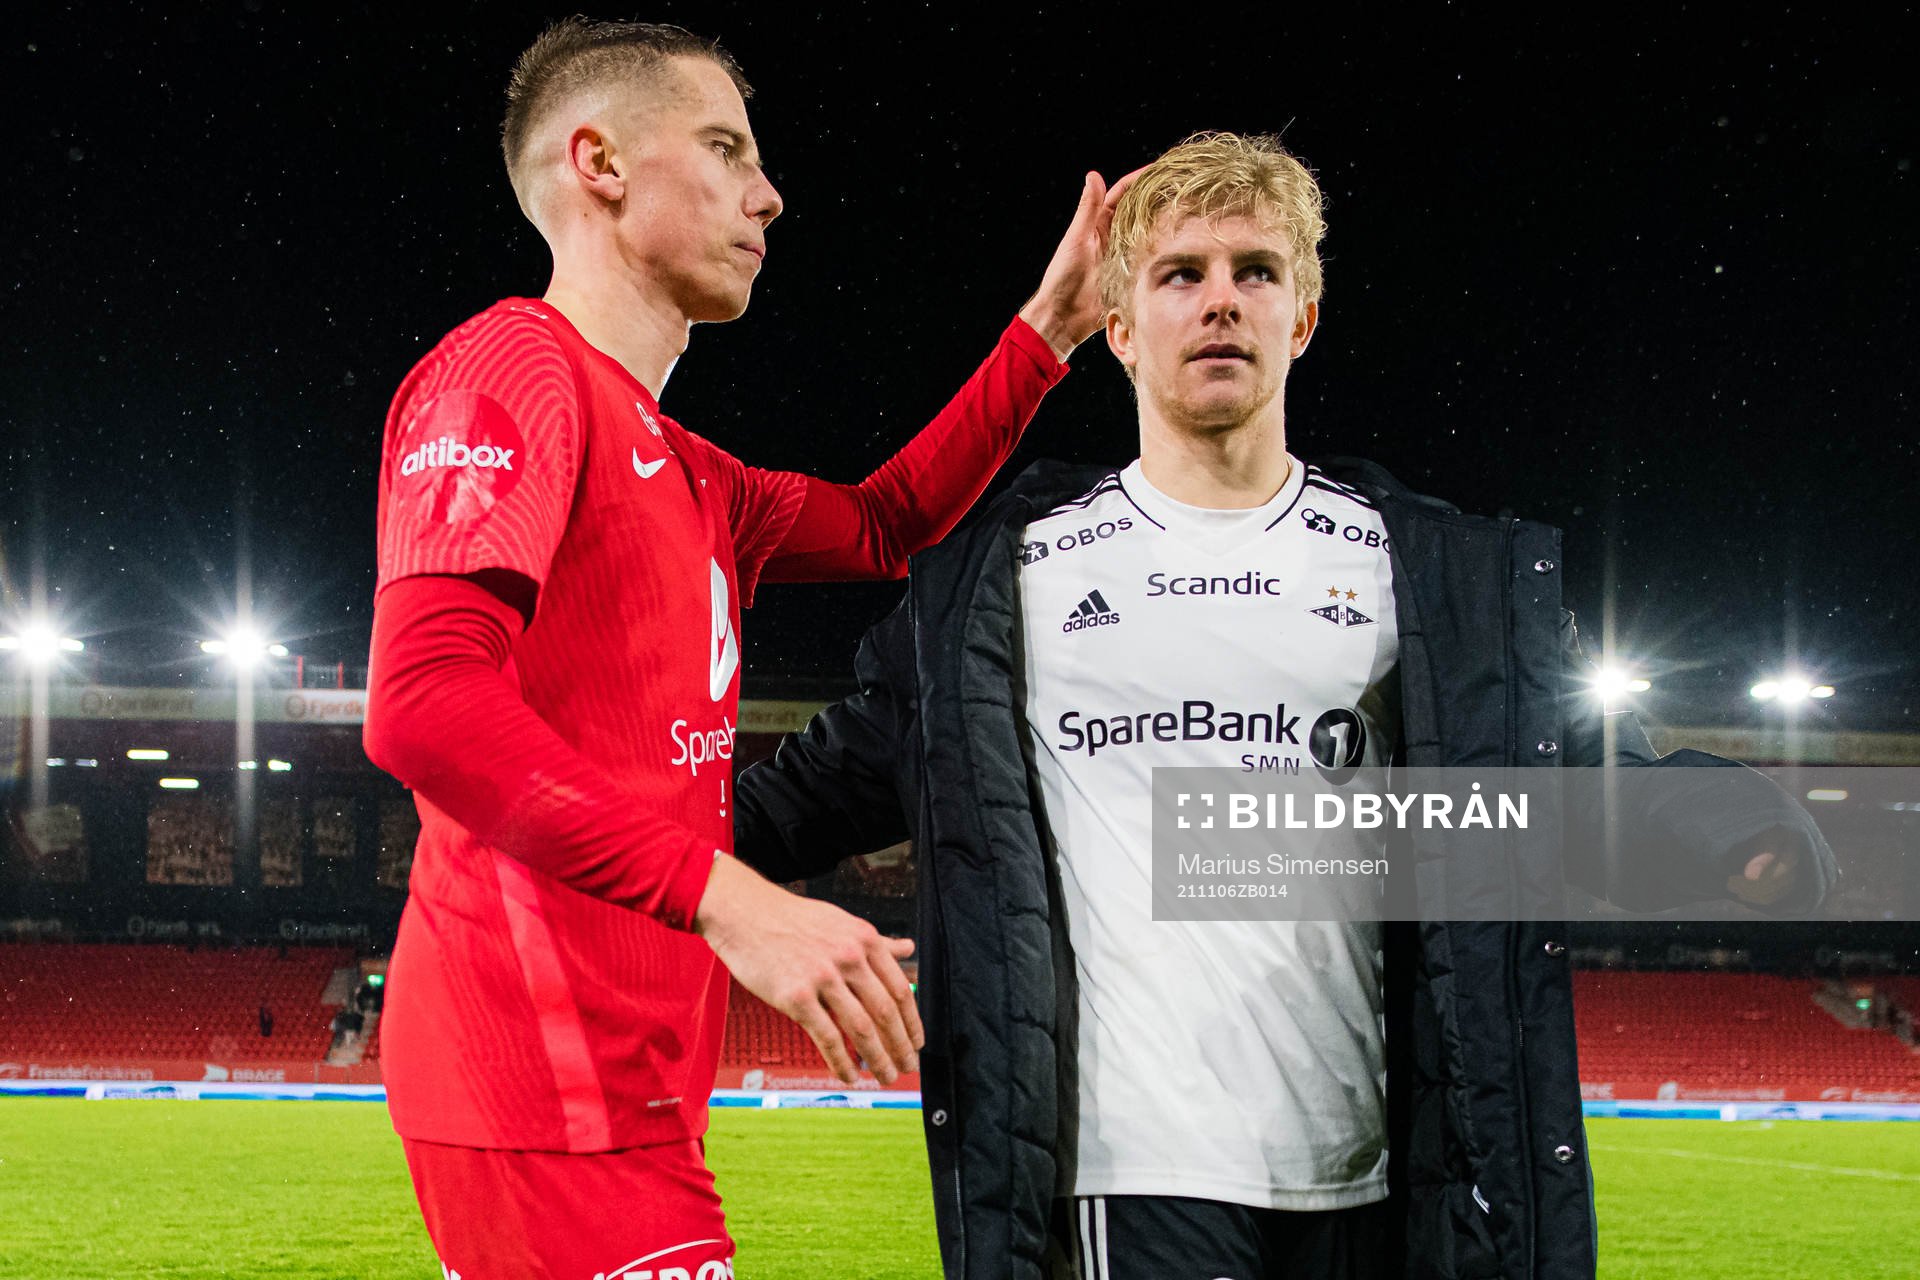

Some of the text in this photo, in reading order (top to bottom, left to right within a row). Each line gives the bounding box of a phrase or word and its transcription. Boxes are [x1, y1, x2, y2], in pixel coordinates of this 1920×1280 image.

[401, 436, 515, 477] altibox
[1056, 517, 1134, 551] OBOS
[1146, 571, 1281, 597] Scandic
[1062, 612, 1121, 633] adidas
[1058, 700, 1301, 757] SpareBank
[1241, 754, 1300, 777] SMN
